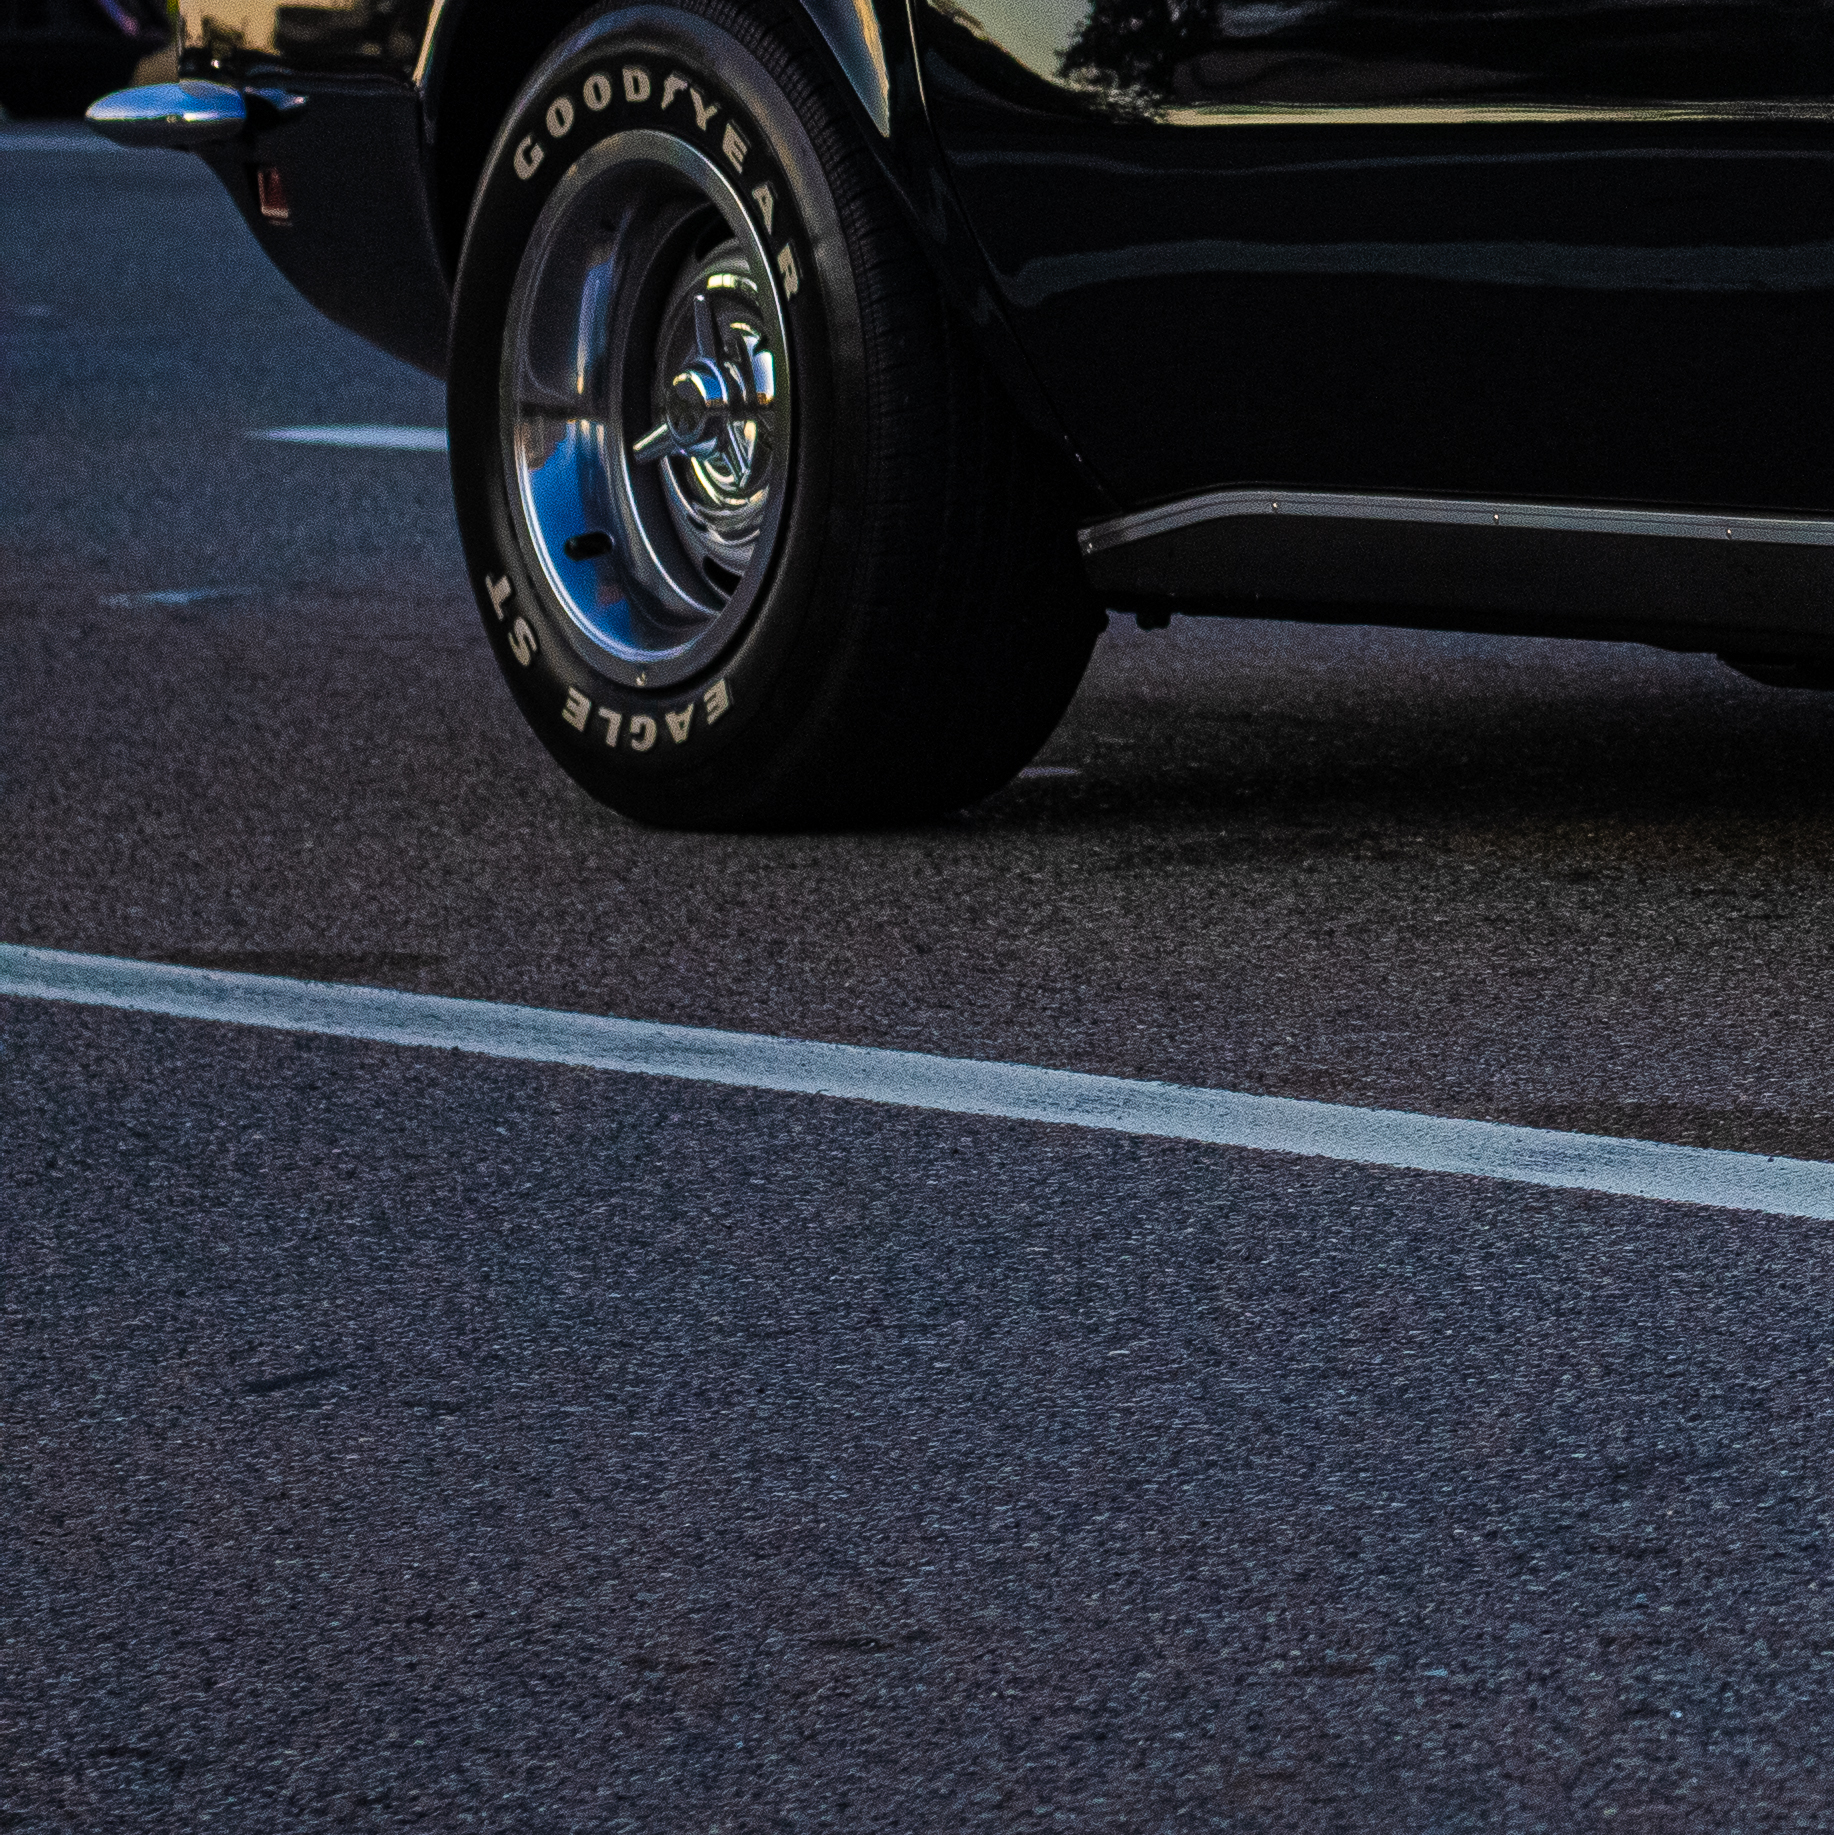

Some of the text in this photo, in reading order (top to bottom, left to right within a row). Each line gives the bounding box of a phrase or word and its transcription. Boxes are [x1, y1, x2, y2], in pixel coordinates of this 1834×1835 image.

[513, 63, 802, 302] GOODYEAR
[485, 572, 733, 753] EAGLE ST
